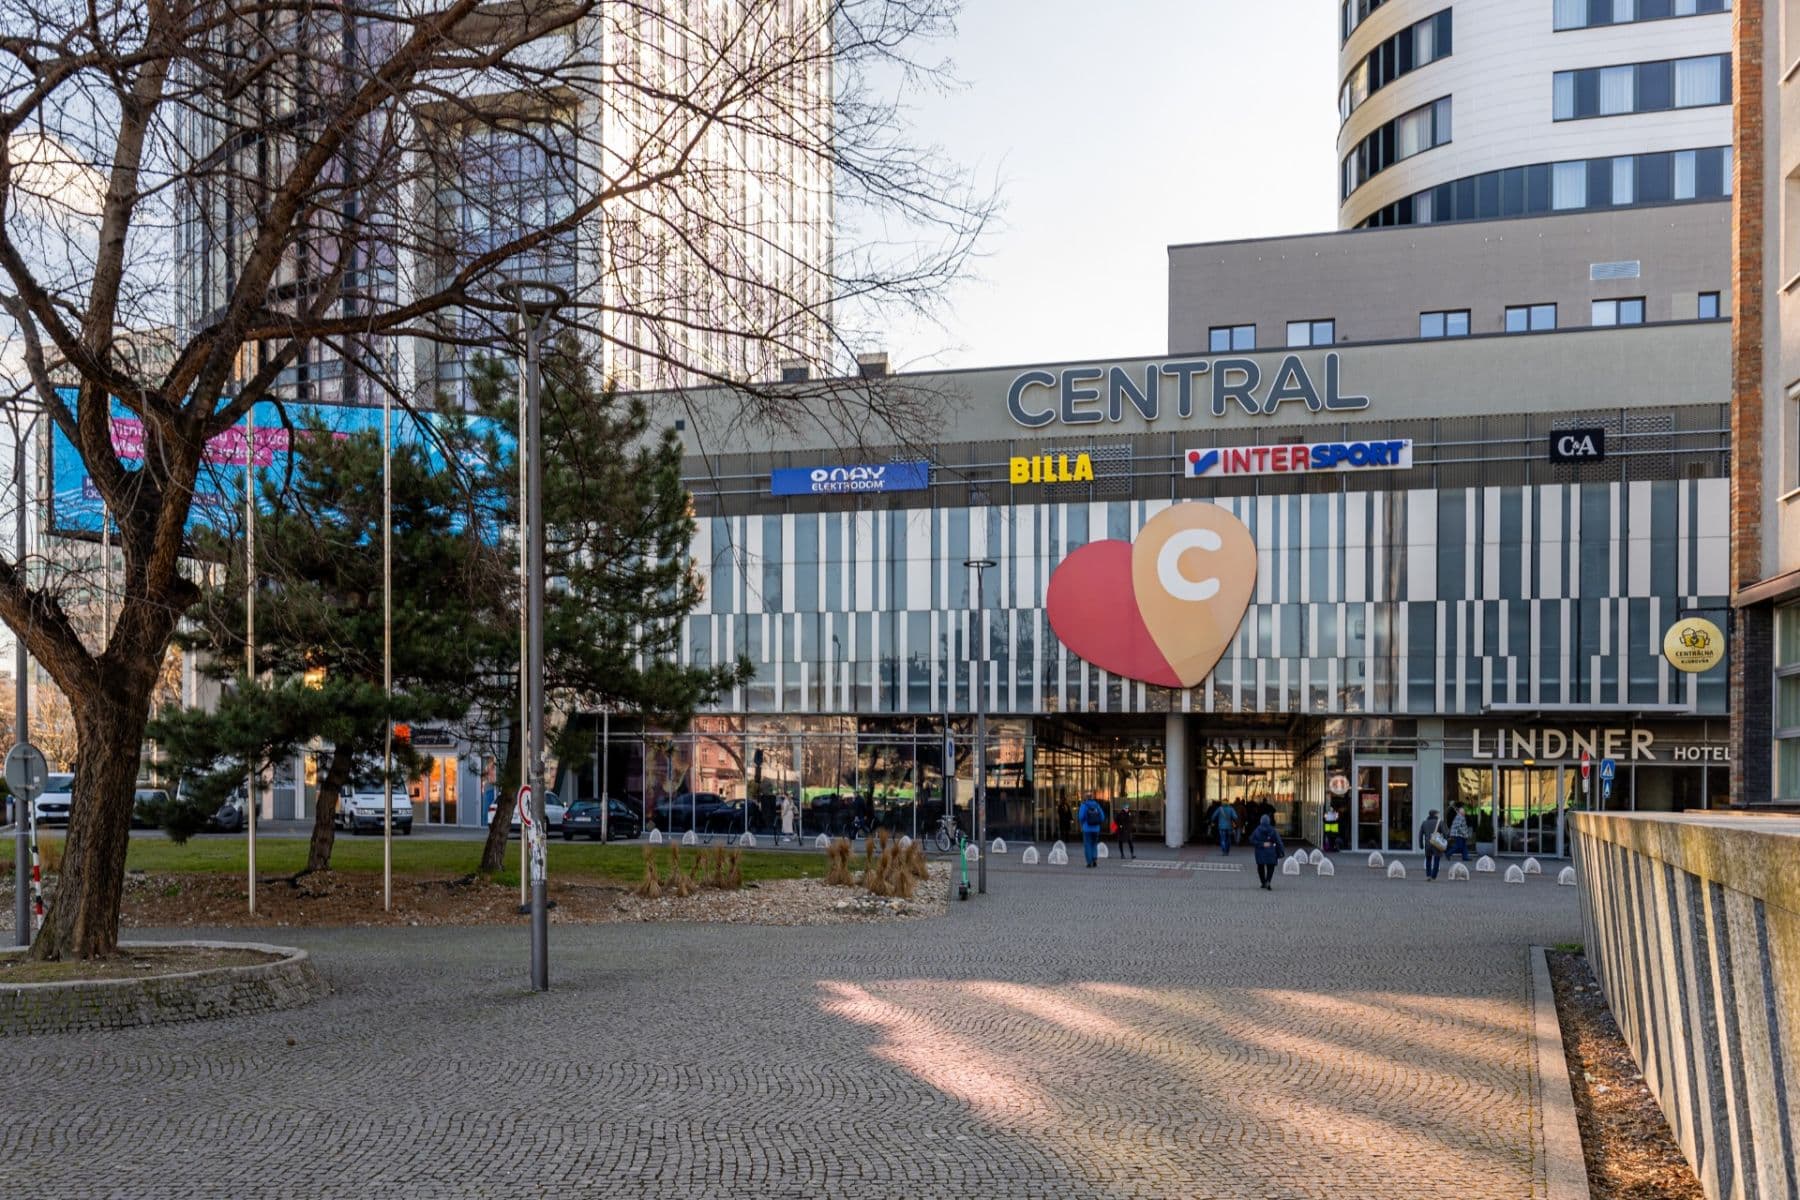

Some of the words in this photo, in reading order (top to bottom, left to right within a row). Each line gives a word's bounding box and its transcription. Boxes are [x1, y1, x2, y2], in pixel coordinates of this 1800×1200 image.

[1007, 352, 1370, 428] CENTRAL
[1223, 441, 1403, 474] INTERSPORT
[1558, 435, 1597, 456] C&A
[1010, 453, 1094, 484] BILLA
[812, 480, 884, 491] ELEKTRODOM
[1157, 528, 1222, 602] C
[1472, 728, 1656, 760] LINDNER
